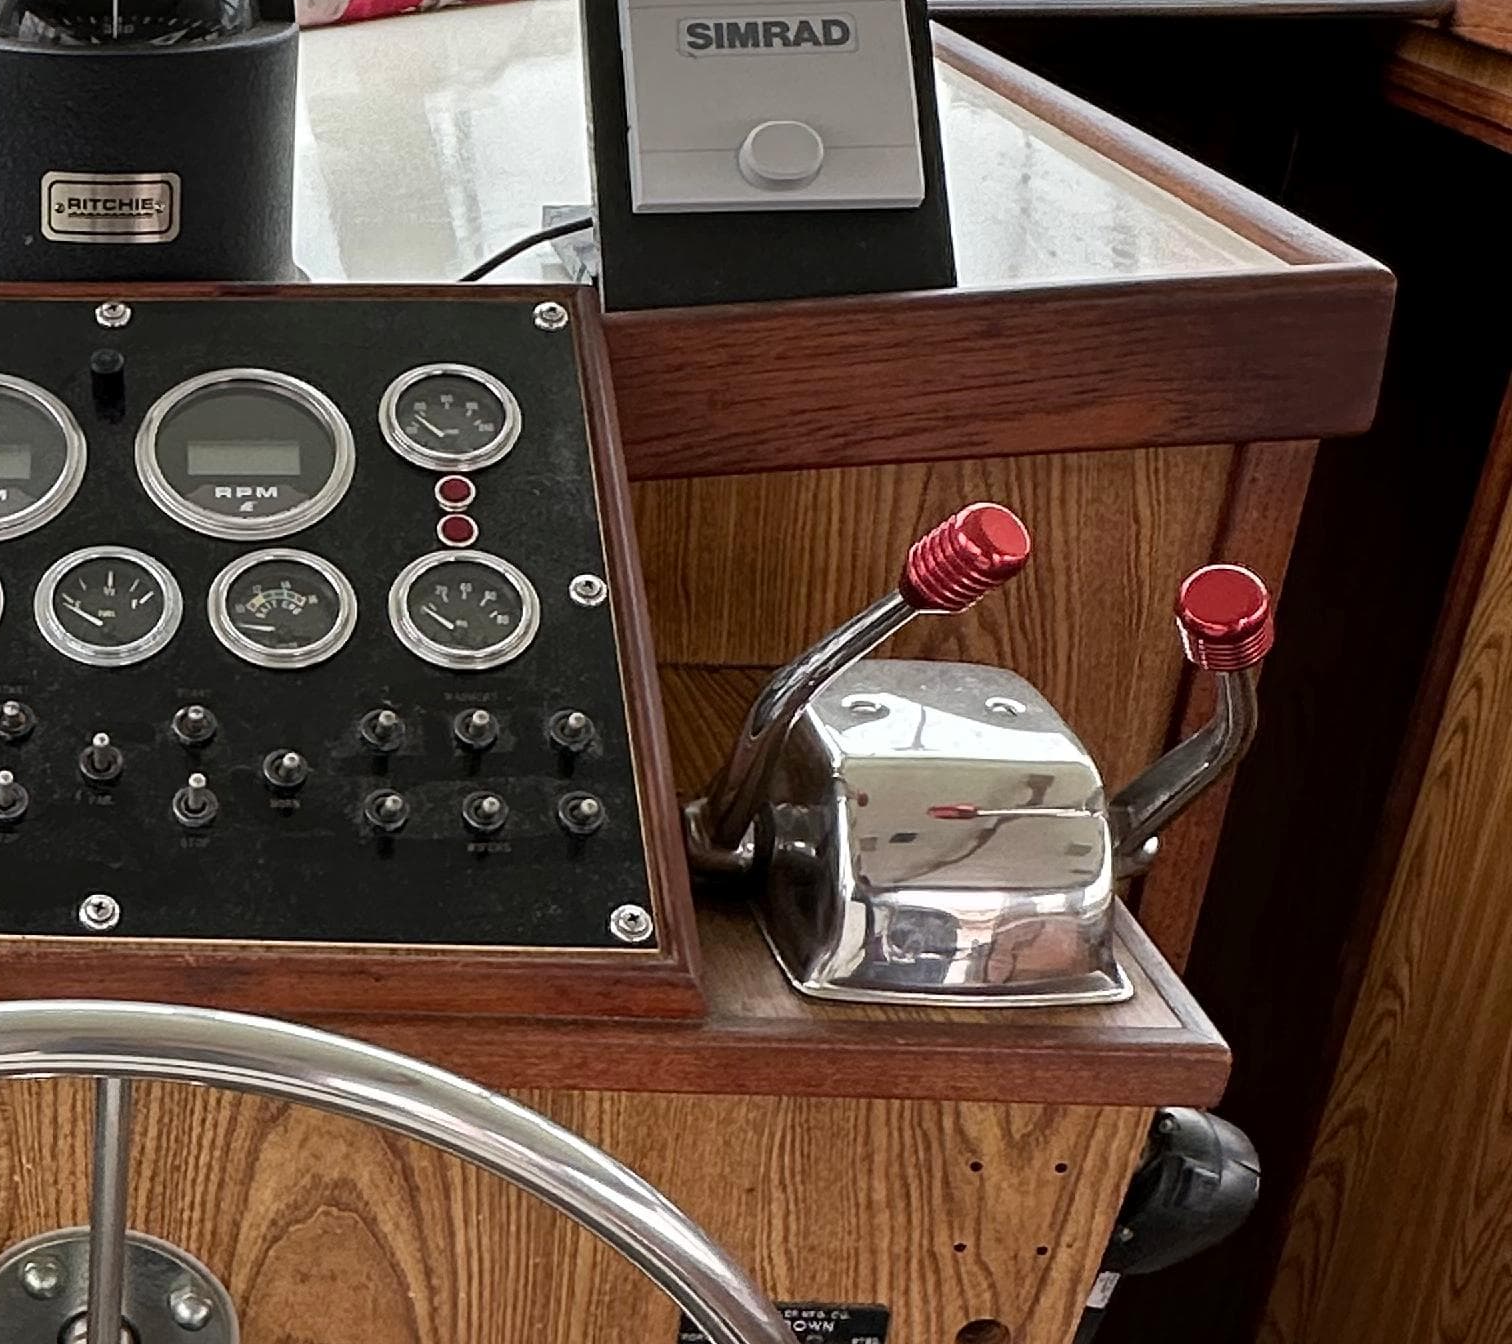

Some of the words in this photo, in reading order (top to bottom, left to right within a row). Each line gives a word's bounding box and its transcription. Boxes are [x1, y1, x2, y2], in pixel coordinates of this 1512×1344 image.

[686, 19, 850, 50] SIMRAD
[67, 198, 154, 211] RITCHIE
[215, 486, 278, 498] RPM
